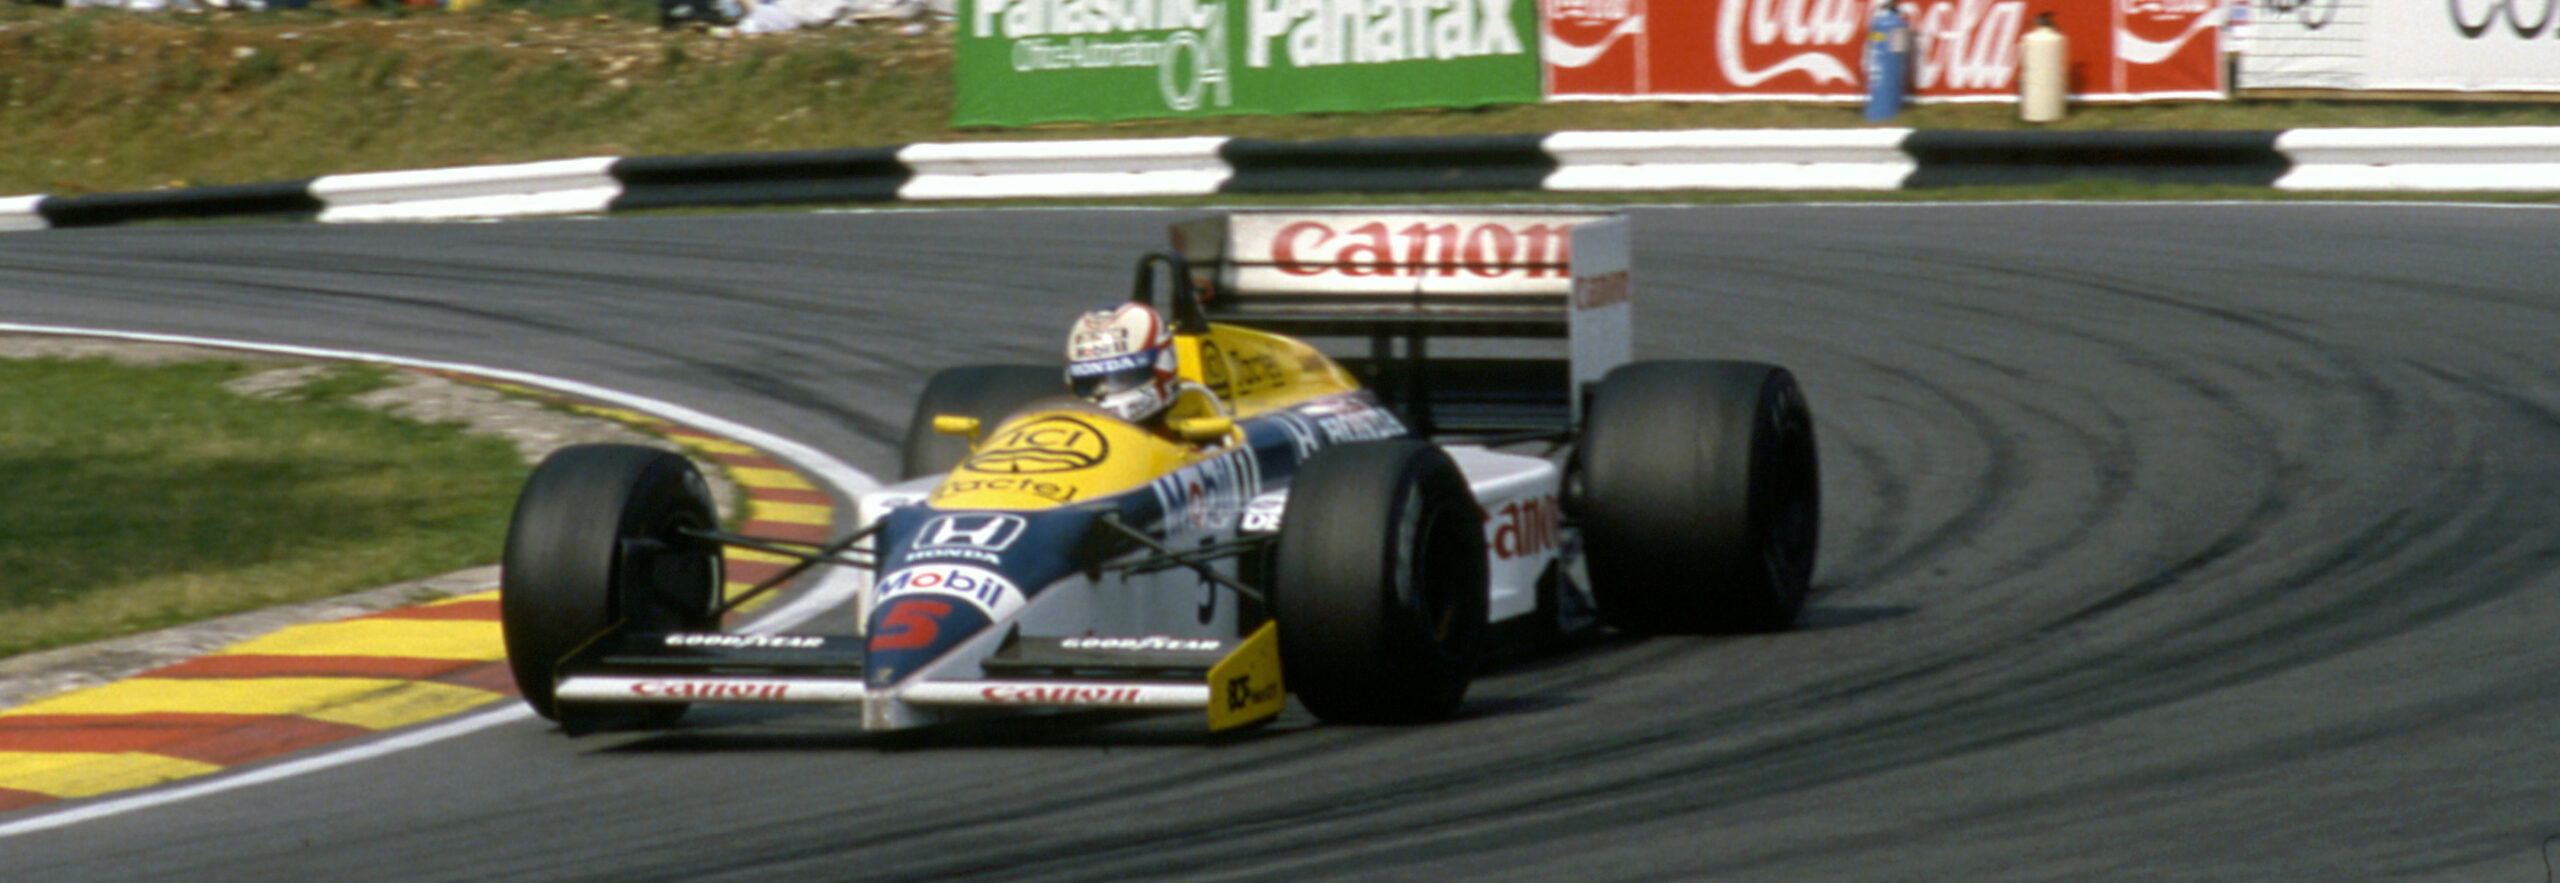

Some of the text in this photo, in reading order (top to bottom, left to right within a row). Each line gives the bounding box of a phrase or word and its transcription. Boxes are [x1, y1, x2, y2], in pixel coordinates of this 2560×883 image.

[1271, 220, 1571, 278] Canon
[1007, 428, 1083, 447] ICI
[906, 549, 1000, 564] HONDA
[877, 569, 1004, 607] Mobil
[868, 601, 952, 651] 5
[631, 682, 790, 698] Canon
[981, 685, 1140, 703] Canon
